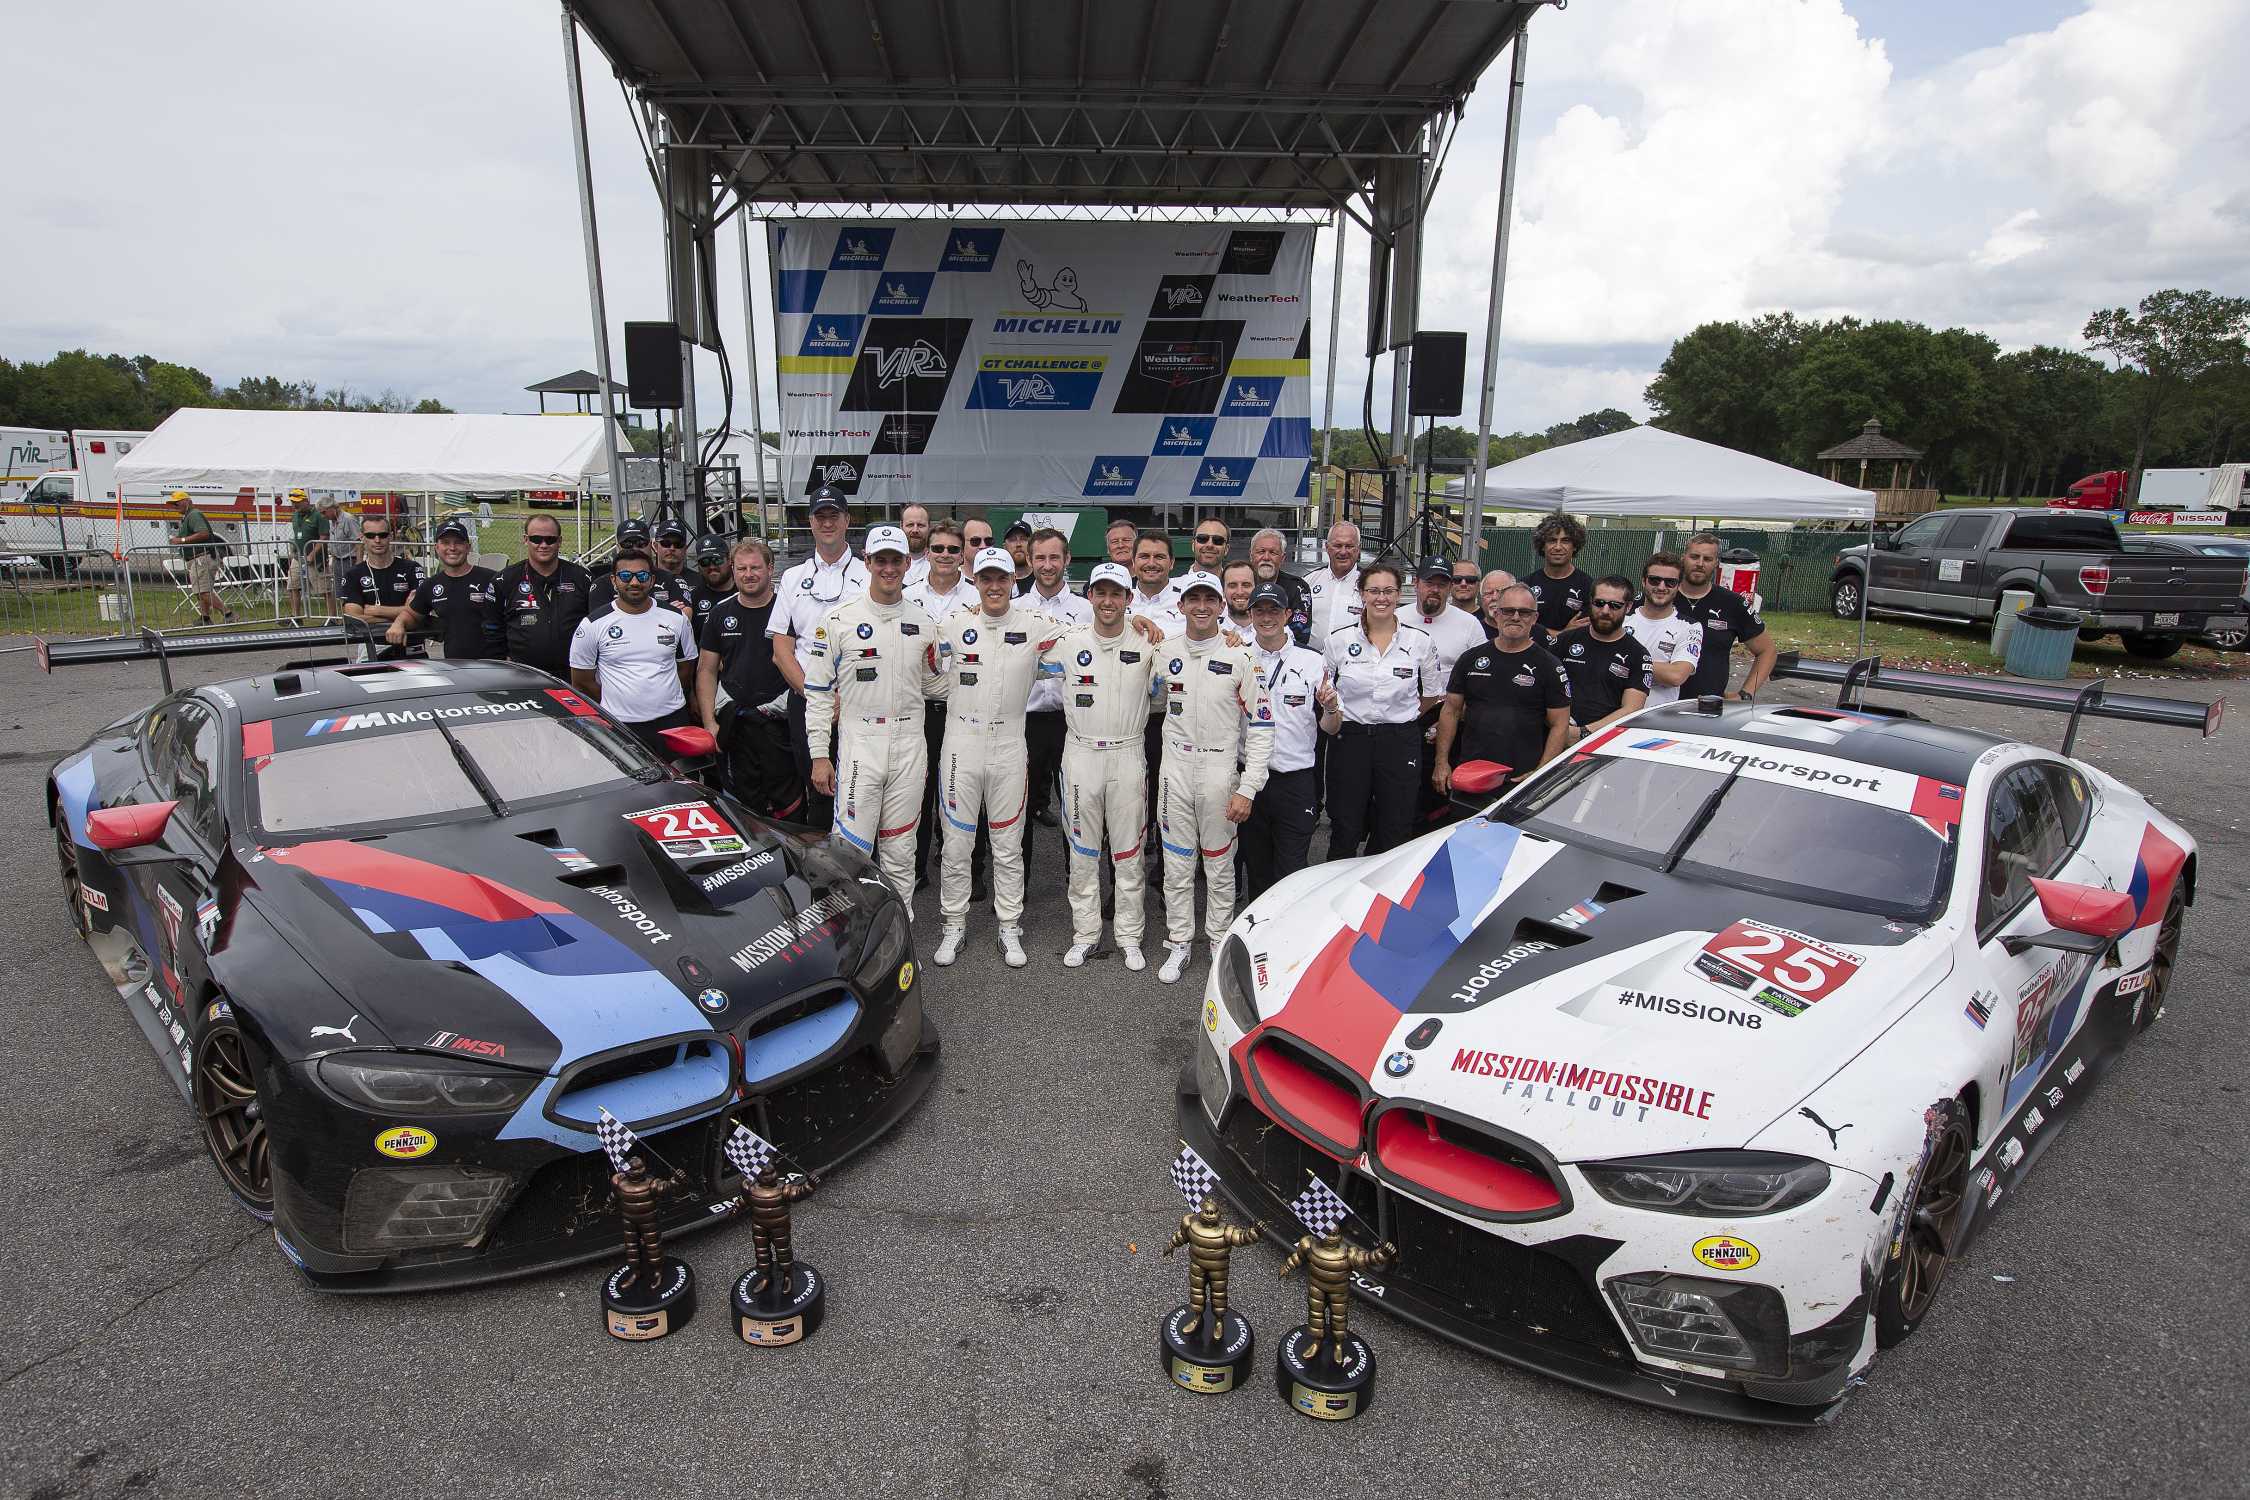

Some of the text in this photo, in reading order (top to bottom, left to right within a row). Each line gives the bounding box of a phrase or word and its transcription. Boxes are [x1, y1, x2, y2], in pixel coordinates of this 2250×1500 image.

[839, 255, 881, 263] MICHELIN
[878, 297, 920, 305] MICHELIN
[1217, 293, 1300, 304] WeatherTech
[992, 318, 1122, 335] MICHELIN
[809, 340, 851, 348] MICHELIN
[983, 359, 1001, 369] GT
[1004, 359, 1089, 369] CHALLENGE
[787, 429, 872, 438] WeatherTech
[1163, 439, 1203, 447] MICHELIN
[1093, 480, 1134, 488] MICHELIN
[2176, 514, 2223, 522] NISSAN
[386, 698, 544, 726] Motorsport
[848, 759, 859, 800] Motorsport
[948, 753, 957, 792] Motorsport
[1700, 747, 1882, 792] Motorsport
[647, 809, 720, 837] 24
[701, 851, 775, 893] #MISSION8
[1745, 918, 1862, 963] WeatherTech
[1716, 930, 1841, 992] 25
[1617, 990, 1763, 1032] #MISSION8
[452, 1036, 505, 1058] IMSA
[1501, 1080, 1651, 1123] FALLOUT
[384, 1135, 429, 1150] PENNZOIL
[1701, 1246, 1753, 1260] PENNZOIL
[608, 1265, 631, 1299] MICHELIN
[661, 1265, 688, 1300] MICHELIN
[738, 1269, 759, 1304] MICHELIN
[793, 1270, 817, 1305] MICHELIN
[1168, 1308, 1186, 1346] MICHELIN
[1226, 1317, 1249, 1354] MICHELIN
[1286, 1331, 1305, 1370] MICHELIN
[1347, 1341, 1368, 1379] MICHELIN
